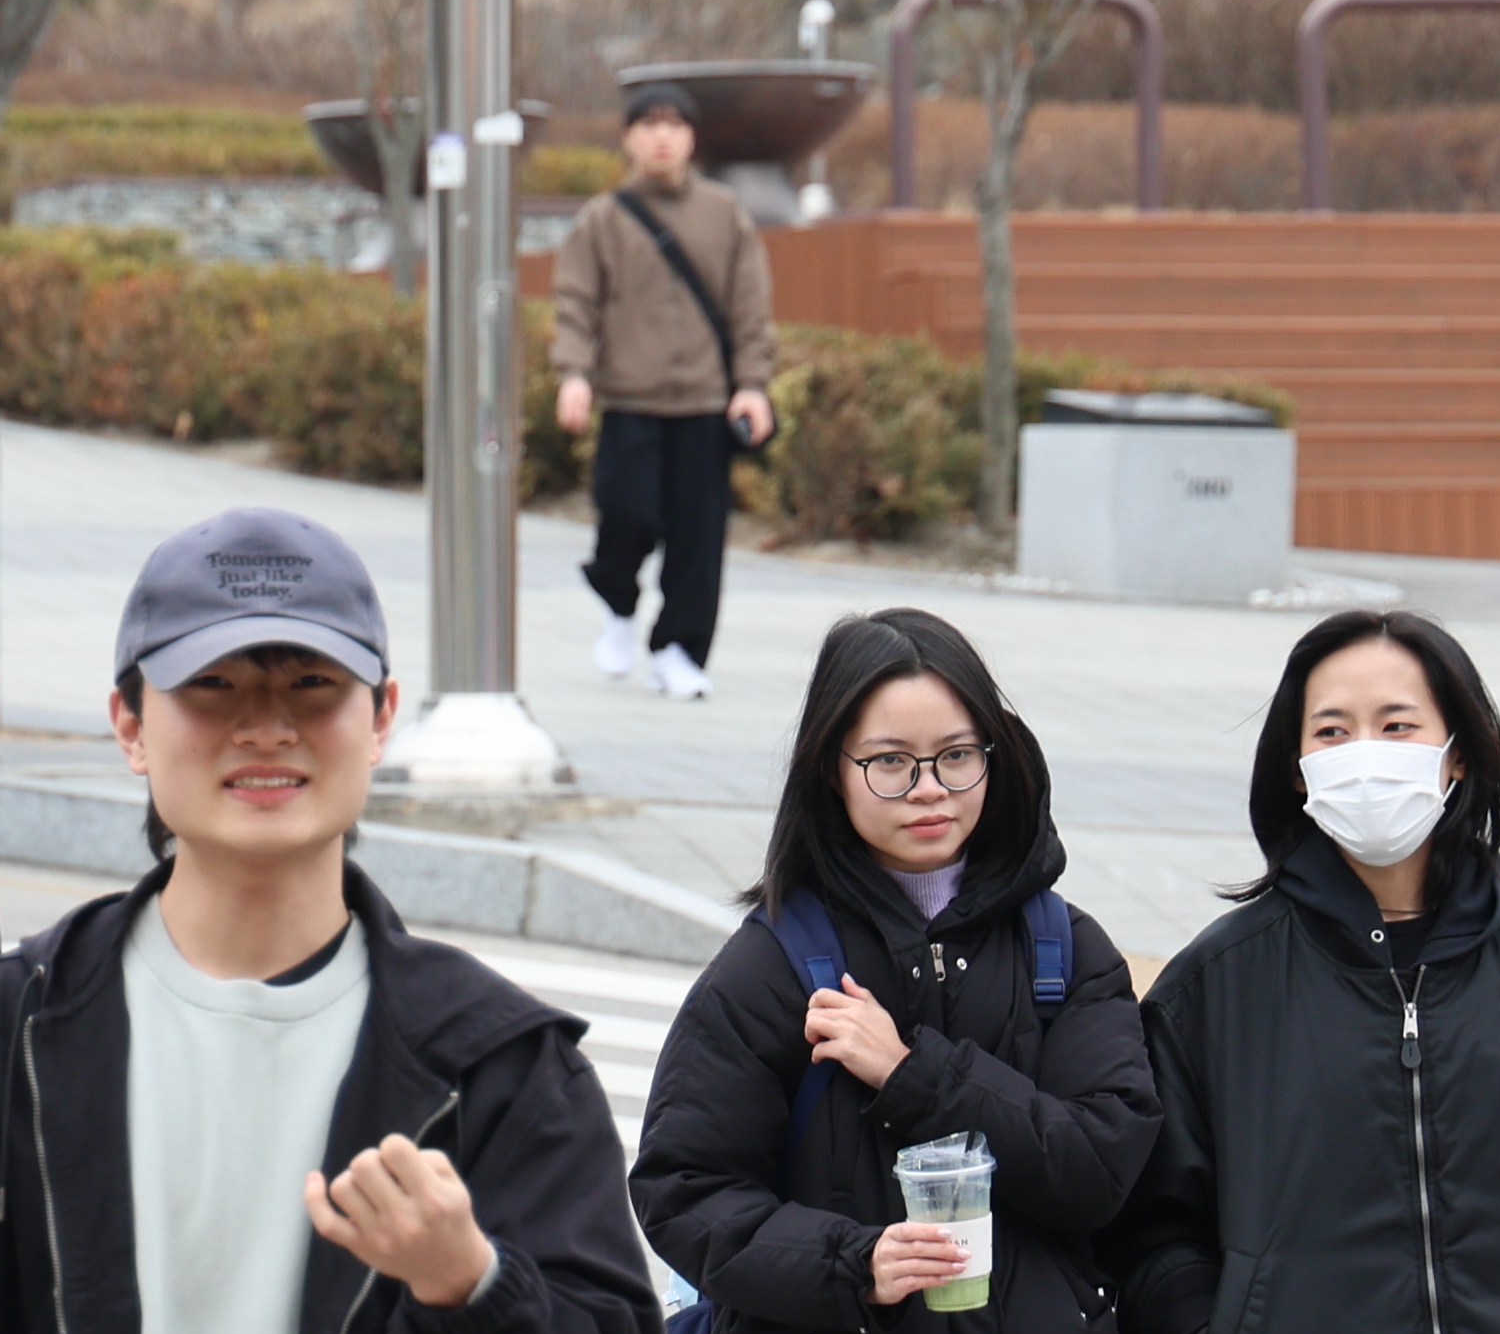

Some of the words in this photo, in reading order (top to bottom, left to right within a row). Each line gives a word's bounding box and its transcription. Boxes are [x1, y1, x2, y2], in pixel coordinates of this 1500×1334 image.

[205, 552, 313, 568] Tomorrow
[217, 569, 257, 589] just
[264, 568, 302, 583] like
[231, 582, 293, 601] today.
